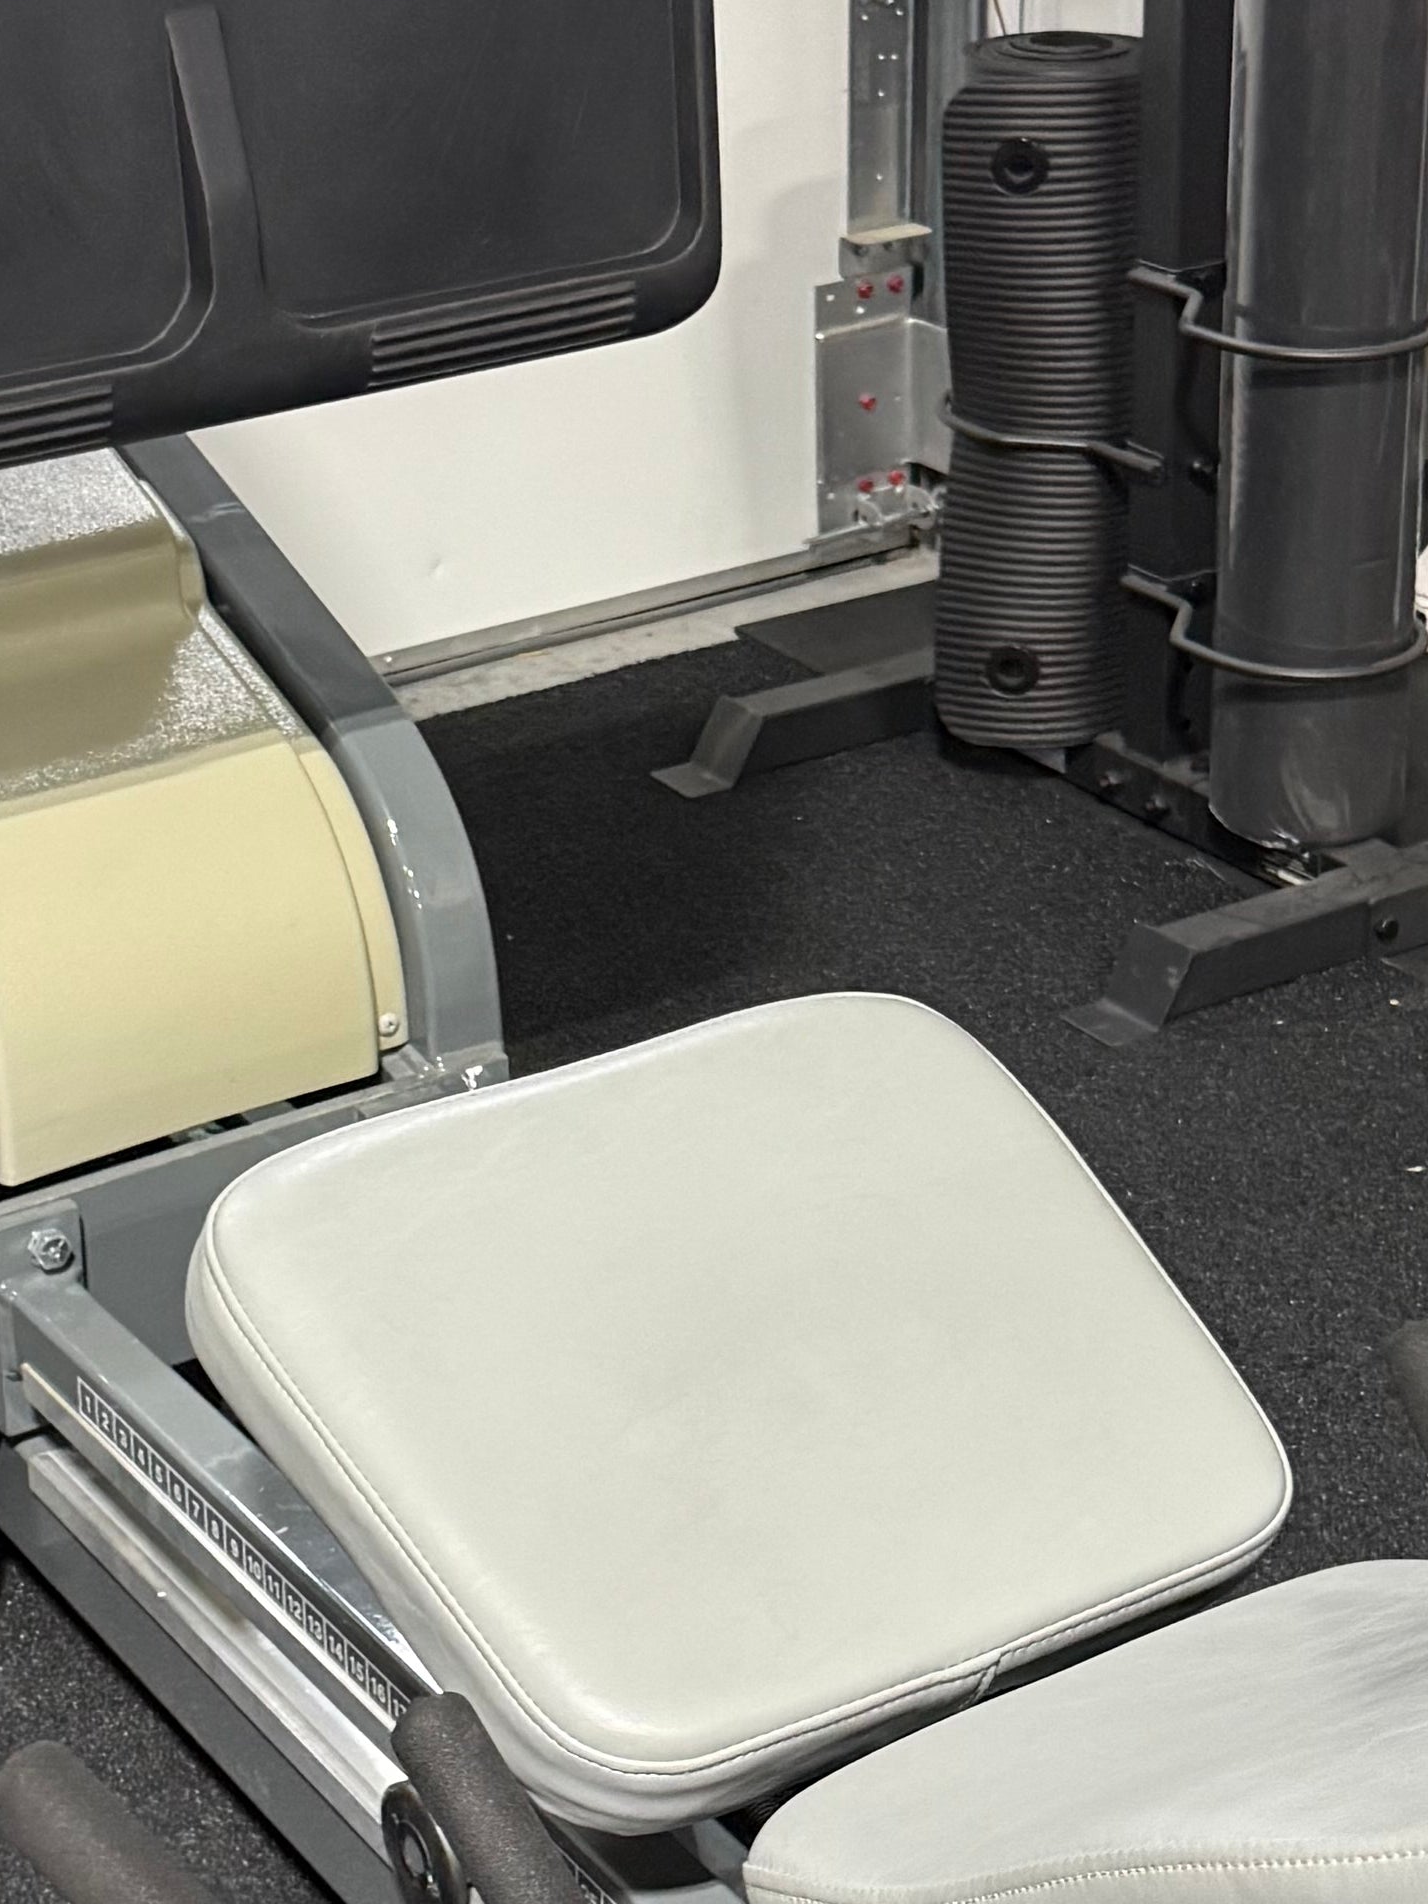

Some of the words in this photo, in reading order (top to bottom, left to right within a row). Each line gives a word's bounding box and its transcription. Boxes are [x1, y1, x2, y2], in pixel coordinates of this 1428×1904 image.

[192, 1499, 200, 1519] 7
[230, 1538, 239, 1558] 9
[248, 1555, 261, 1580] 10
[267, 1575, 280, 1600] 11
[287, 1594, 302, 1621] 12
[308, 1614, 322, 1641] 13
[329, 1635, 344, 1662] 14
[349, 1656, 364, 1682] 15
[371, 1676, 386, 1703] 16
